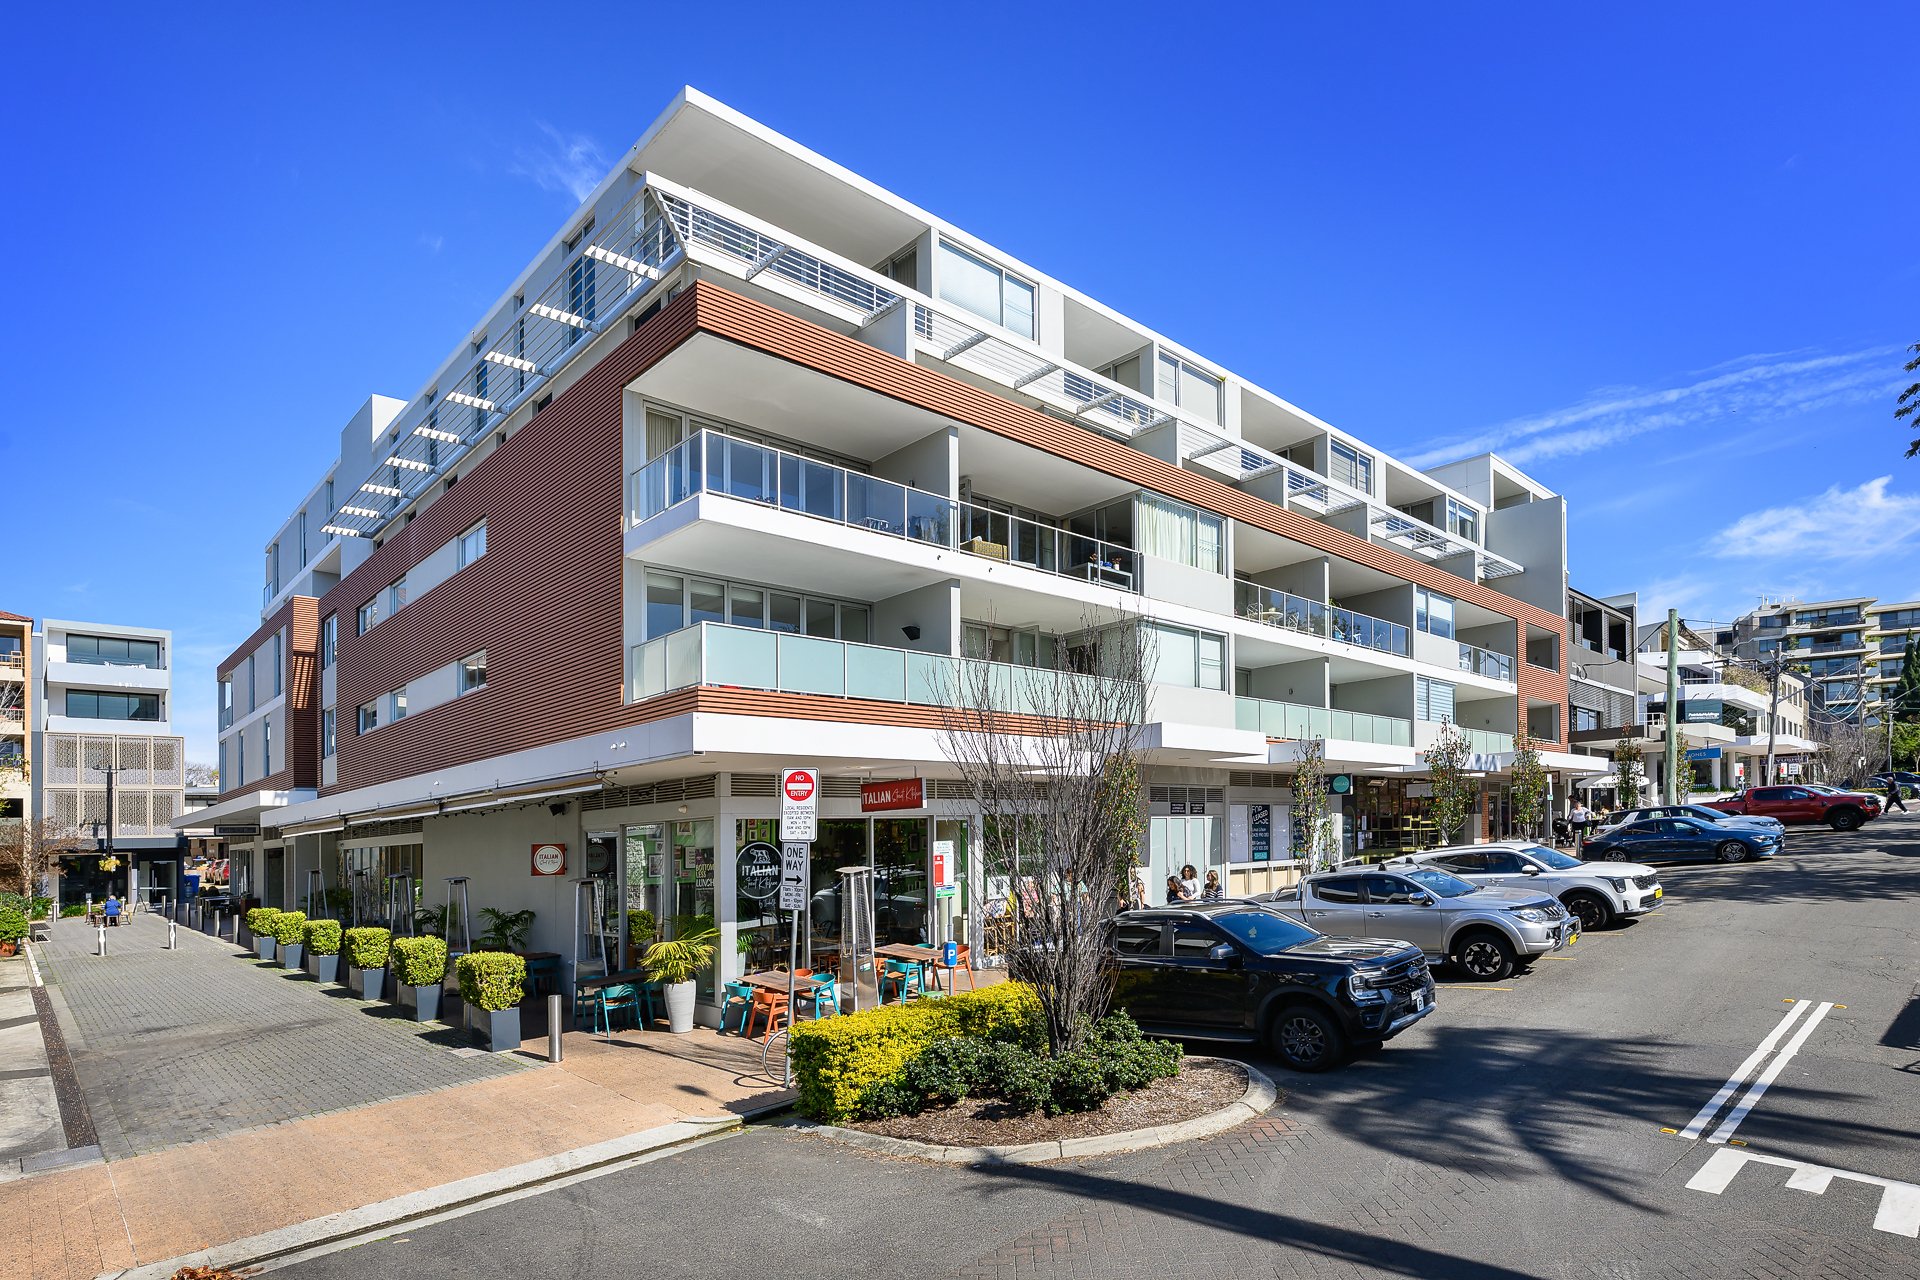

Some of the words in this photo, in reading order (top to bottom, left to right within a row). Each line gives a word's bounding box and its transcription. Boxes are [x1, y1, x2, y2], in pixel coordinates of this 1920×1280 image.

[861, 790, 891, 805] ITALIAN
[1253, 810, 1268, 822] LEASED
[786, 847, 804, 858] ONE
[741, 864, 779, 876] ITALIAN
[785, 859, 804, 871] WAY
[695, 870, 707, 879] LESS
[695, 878, 715, 888] LUNCH
[947, 949, 956, 960] P
[1418, 1000, 1422, 1009] P
